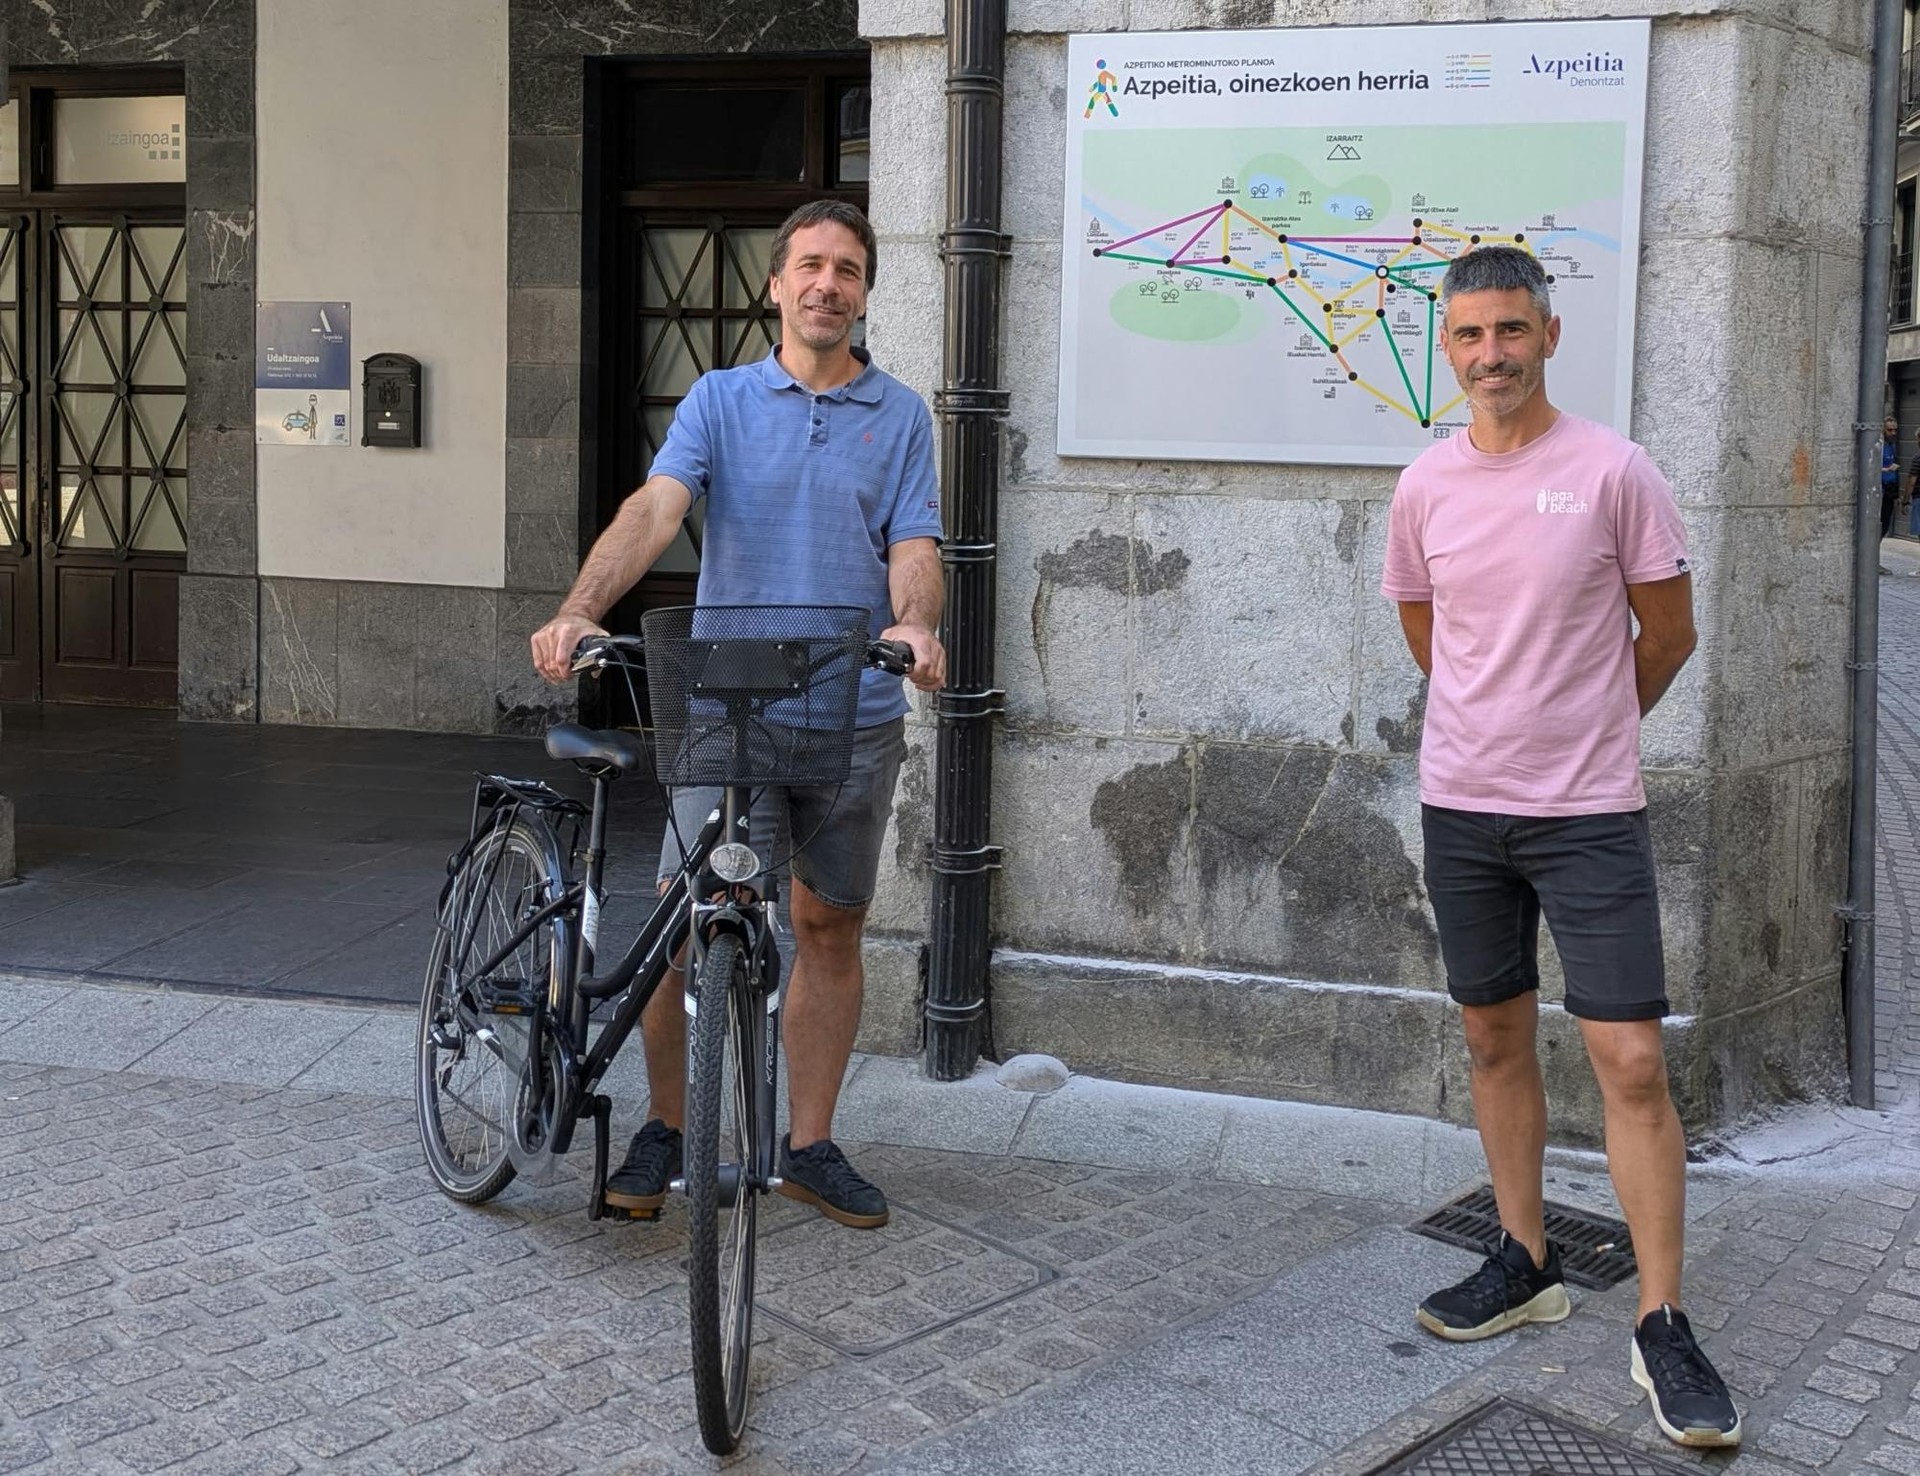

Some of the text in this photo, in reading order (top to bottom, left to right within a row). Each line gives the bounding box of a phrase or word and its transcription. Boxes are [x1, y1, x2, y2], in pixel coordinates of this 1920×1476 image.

[1124, 58, 1275, 69] AZPEITIKO METROMINUTOKO PLANOA
[1522, 52, 1624, 80] Azpeitia
[1123, 69, 1429, 100] Azpeitia, oinezkoen herria
[1570, 77, 1625, 87] Denontzat
[267, 353, 320, 365] Udaltzaingoa
[1547, 489, 1574, 503] laga
[1550, 501, 1588, 513] beach
[766, 1015, 774, 1085] KROSS
